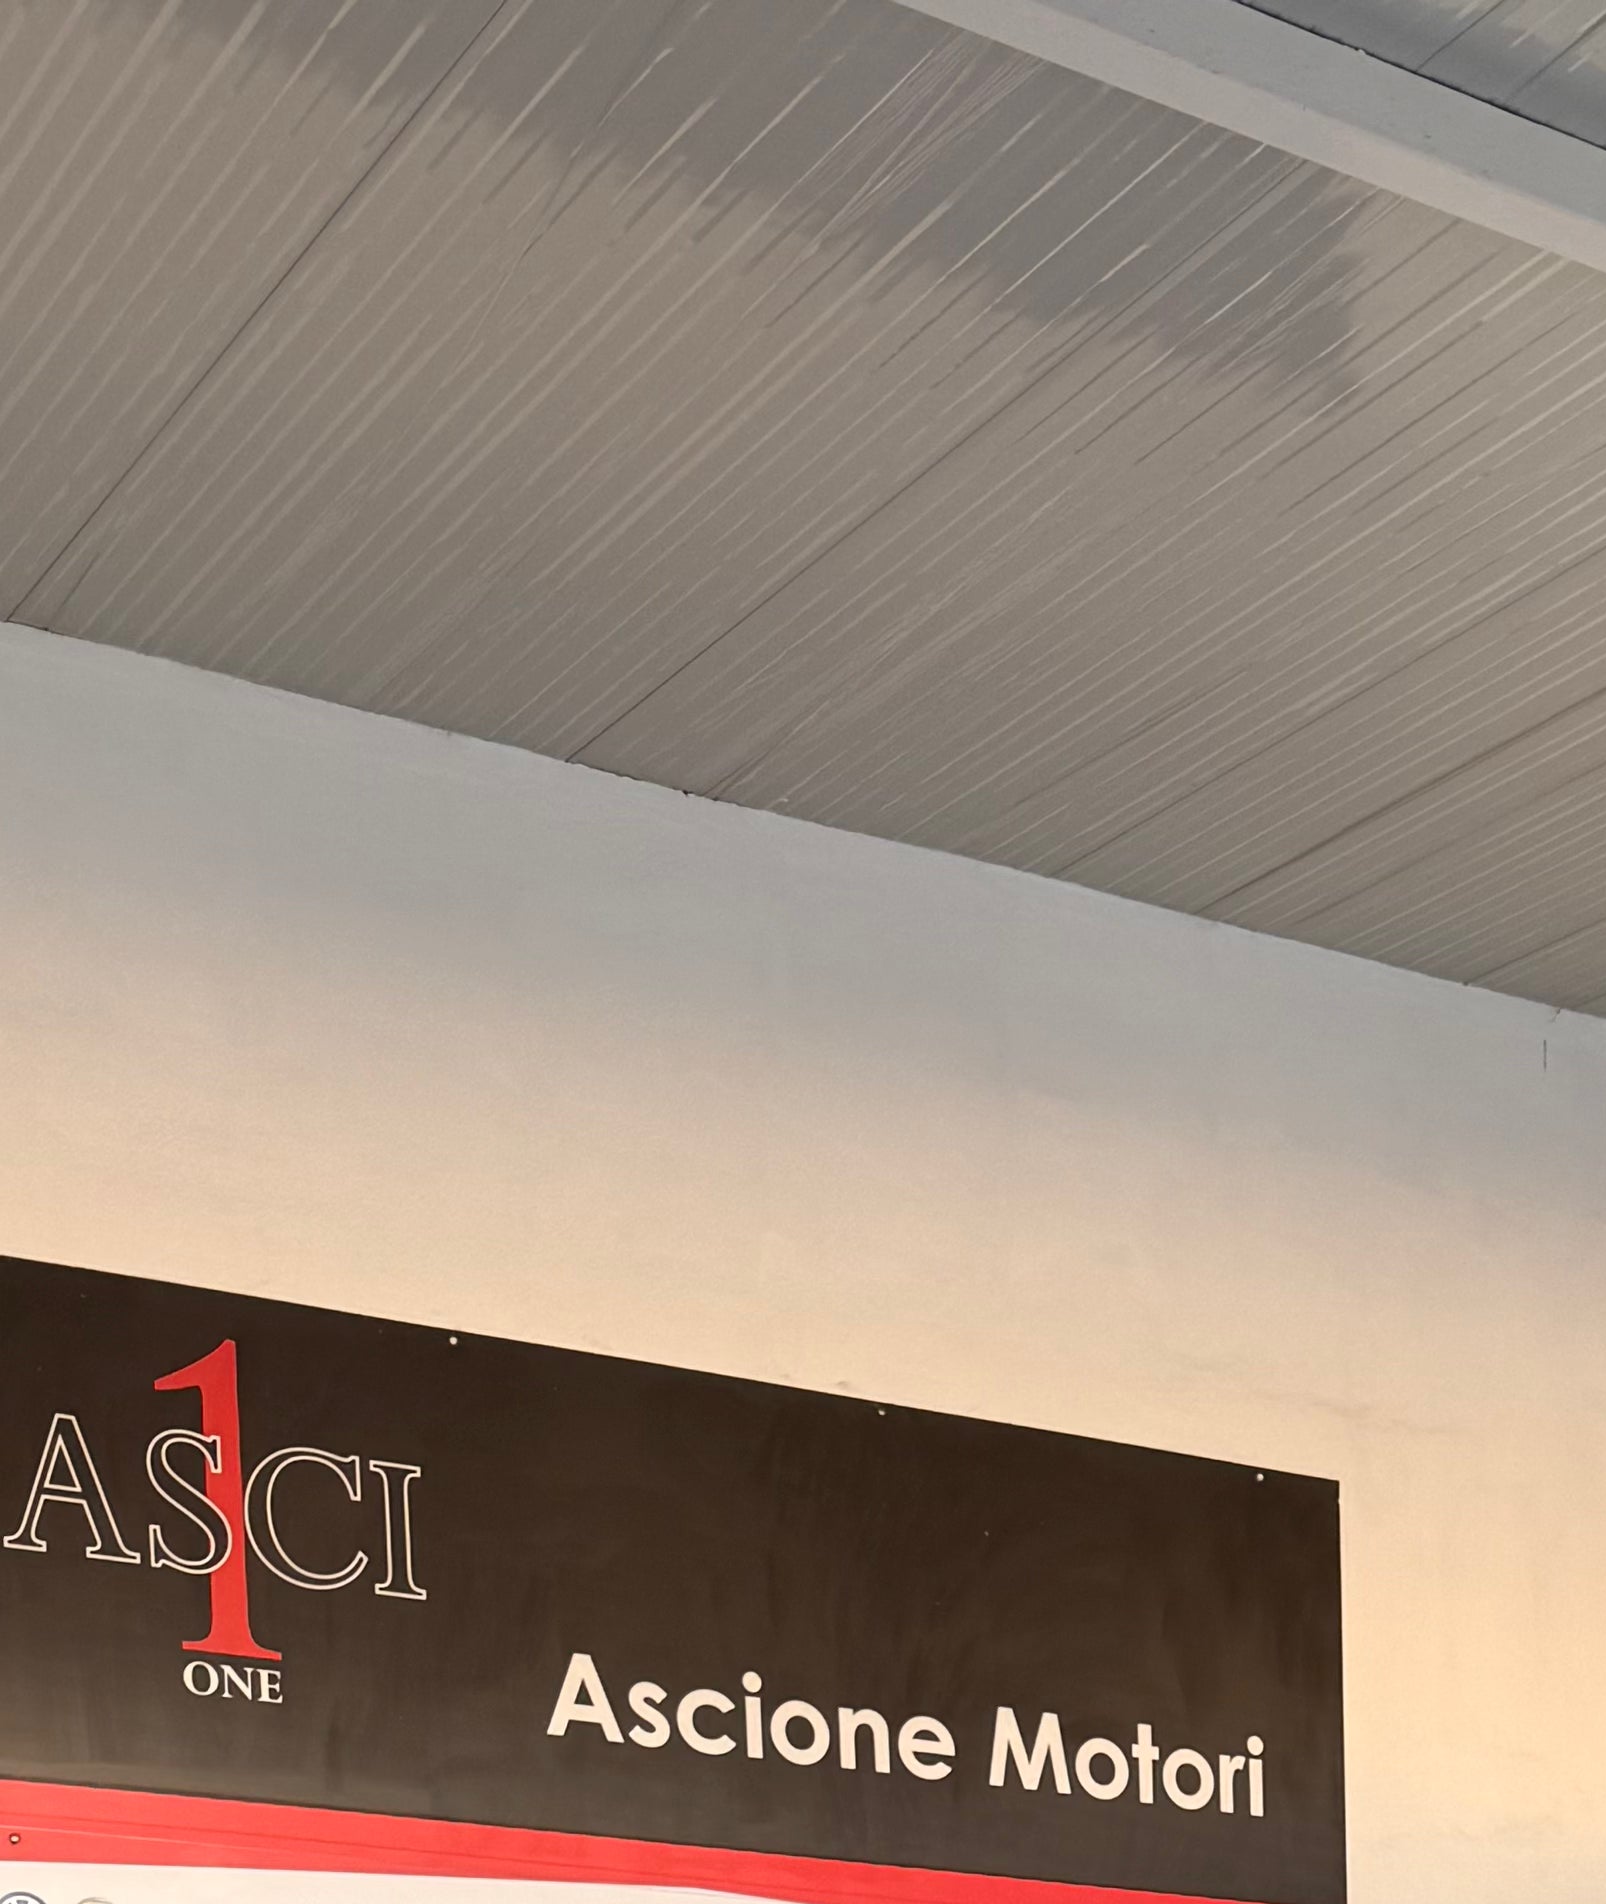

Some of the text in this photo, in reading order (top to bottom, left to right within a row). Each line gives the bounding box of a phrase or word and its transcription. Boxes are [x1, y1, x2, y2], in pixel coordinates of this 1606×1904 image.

[3, 1413, 427, 1600] ASCI
[154, 1339, 282, 1661] 1
[183, 1661, 283, 1703] ONE
[547, 1652, 1264, 1817] Ascione Motori
